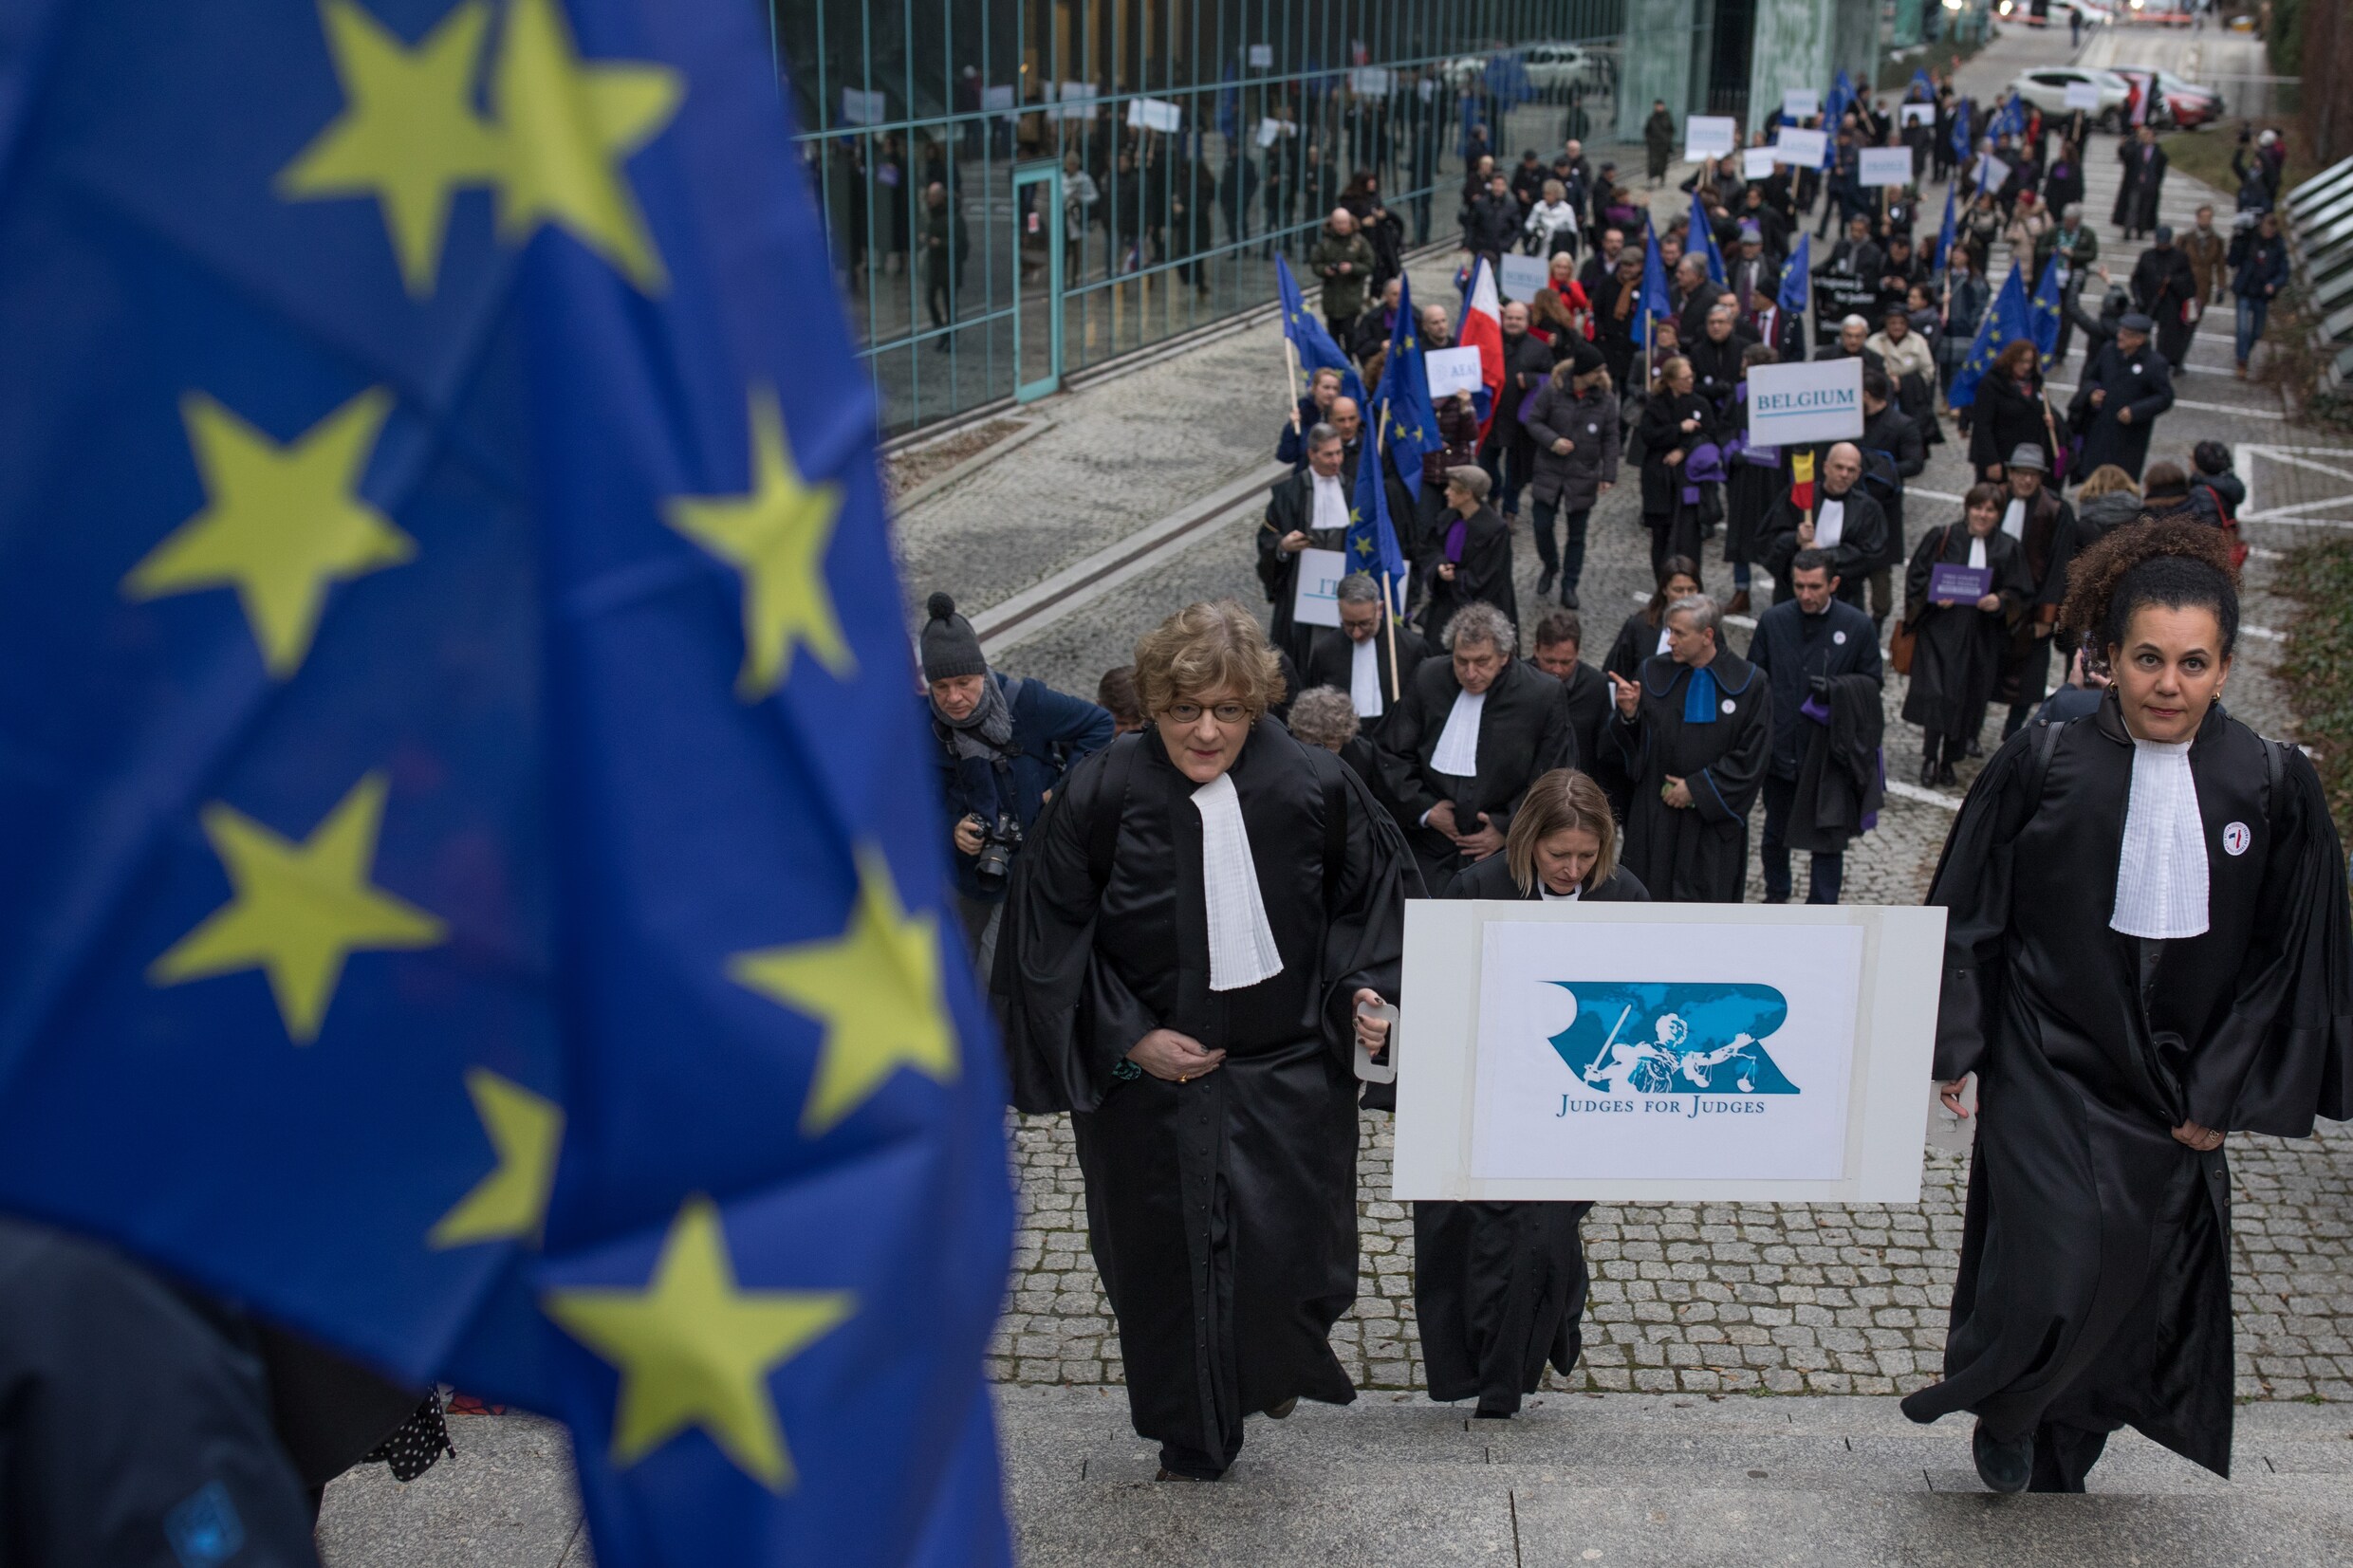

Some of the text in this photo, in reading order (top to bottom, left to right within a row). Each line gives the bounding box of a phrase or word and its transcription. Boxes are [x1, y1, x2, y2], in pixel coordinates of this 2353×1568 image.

[1757, 388, 1855, 410] BELGIUM
[1555, 1094, 1766, 1119] JUDGES FOR JUDGES
